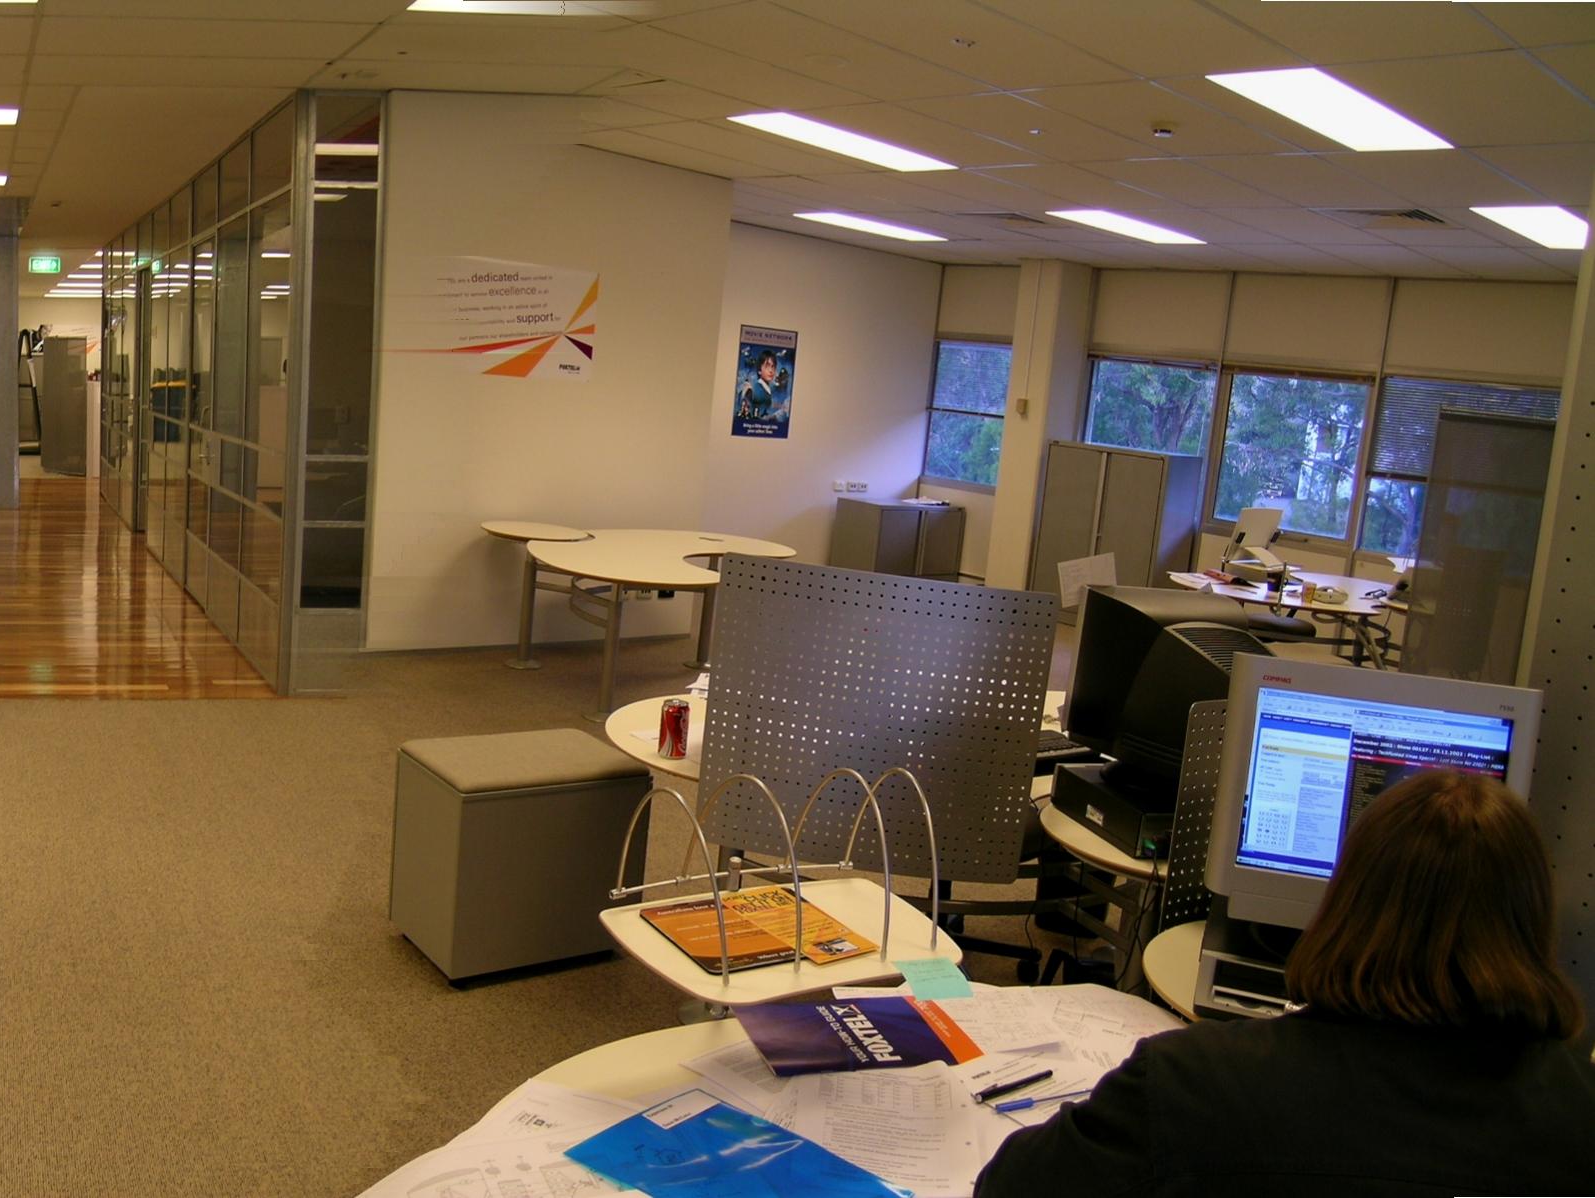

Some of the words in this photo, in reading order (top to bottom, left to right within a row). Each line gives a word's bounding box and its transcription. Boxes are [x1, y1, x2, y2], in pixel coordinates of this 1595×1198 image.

[471, 272, 519, 283] dedicated
[488, 286, 537, 297] excellence
[516, 312, 554, 326] support
[841, 1012, 903, 1062] FOXTEL
